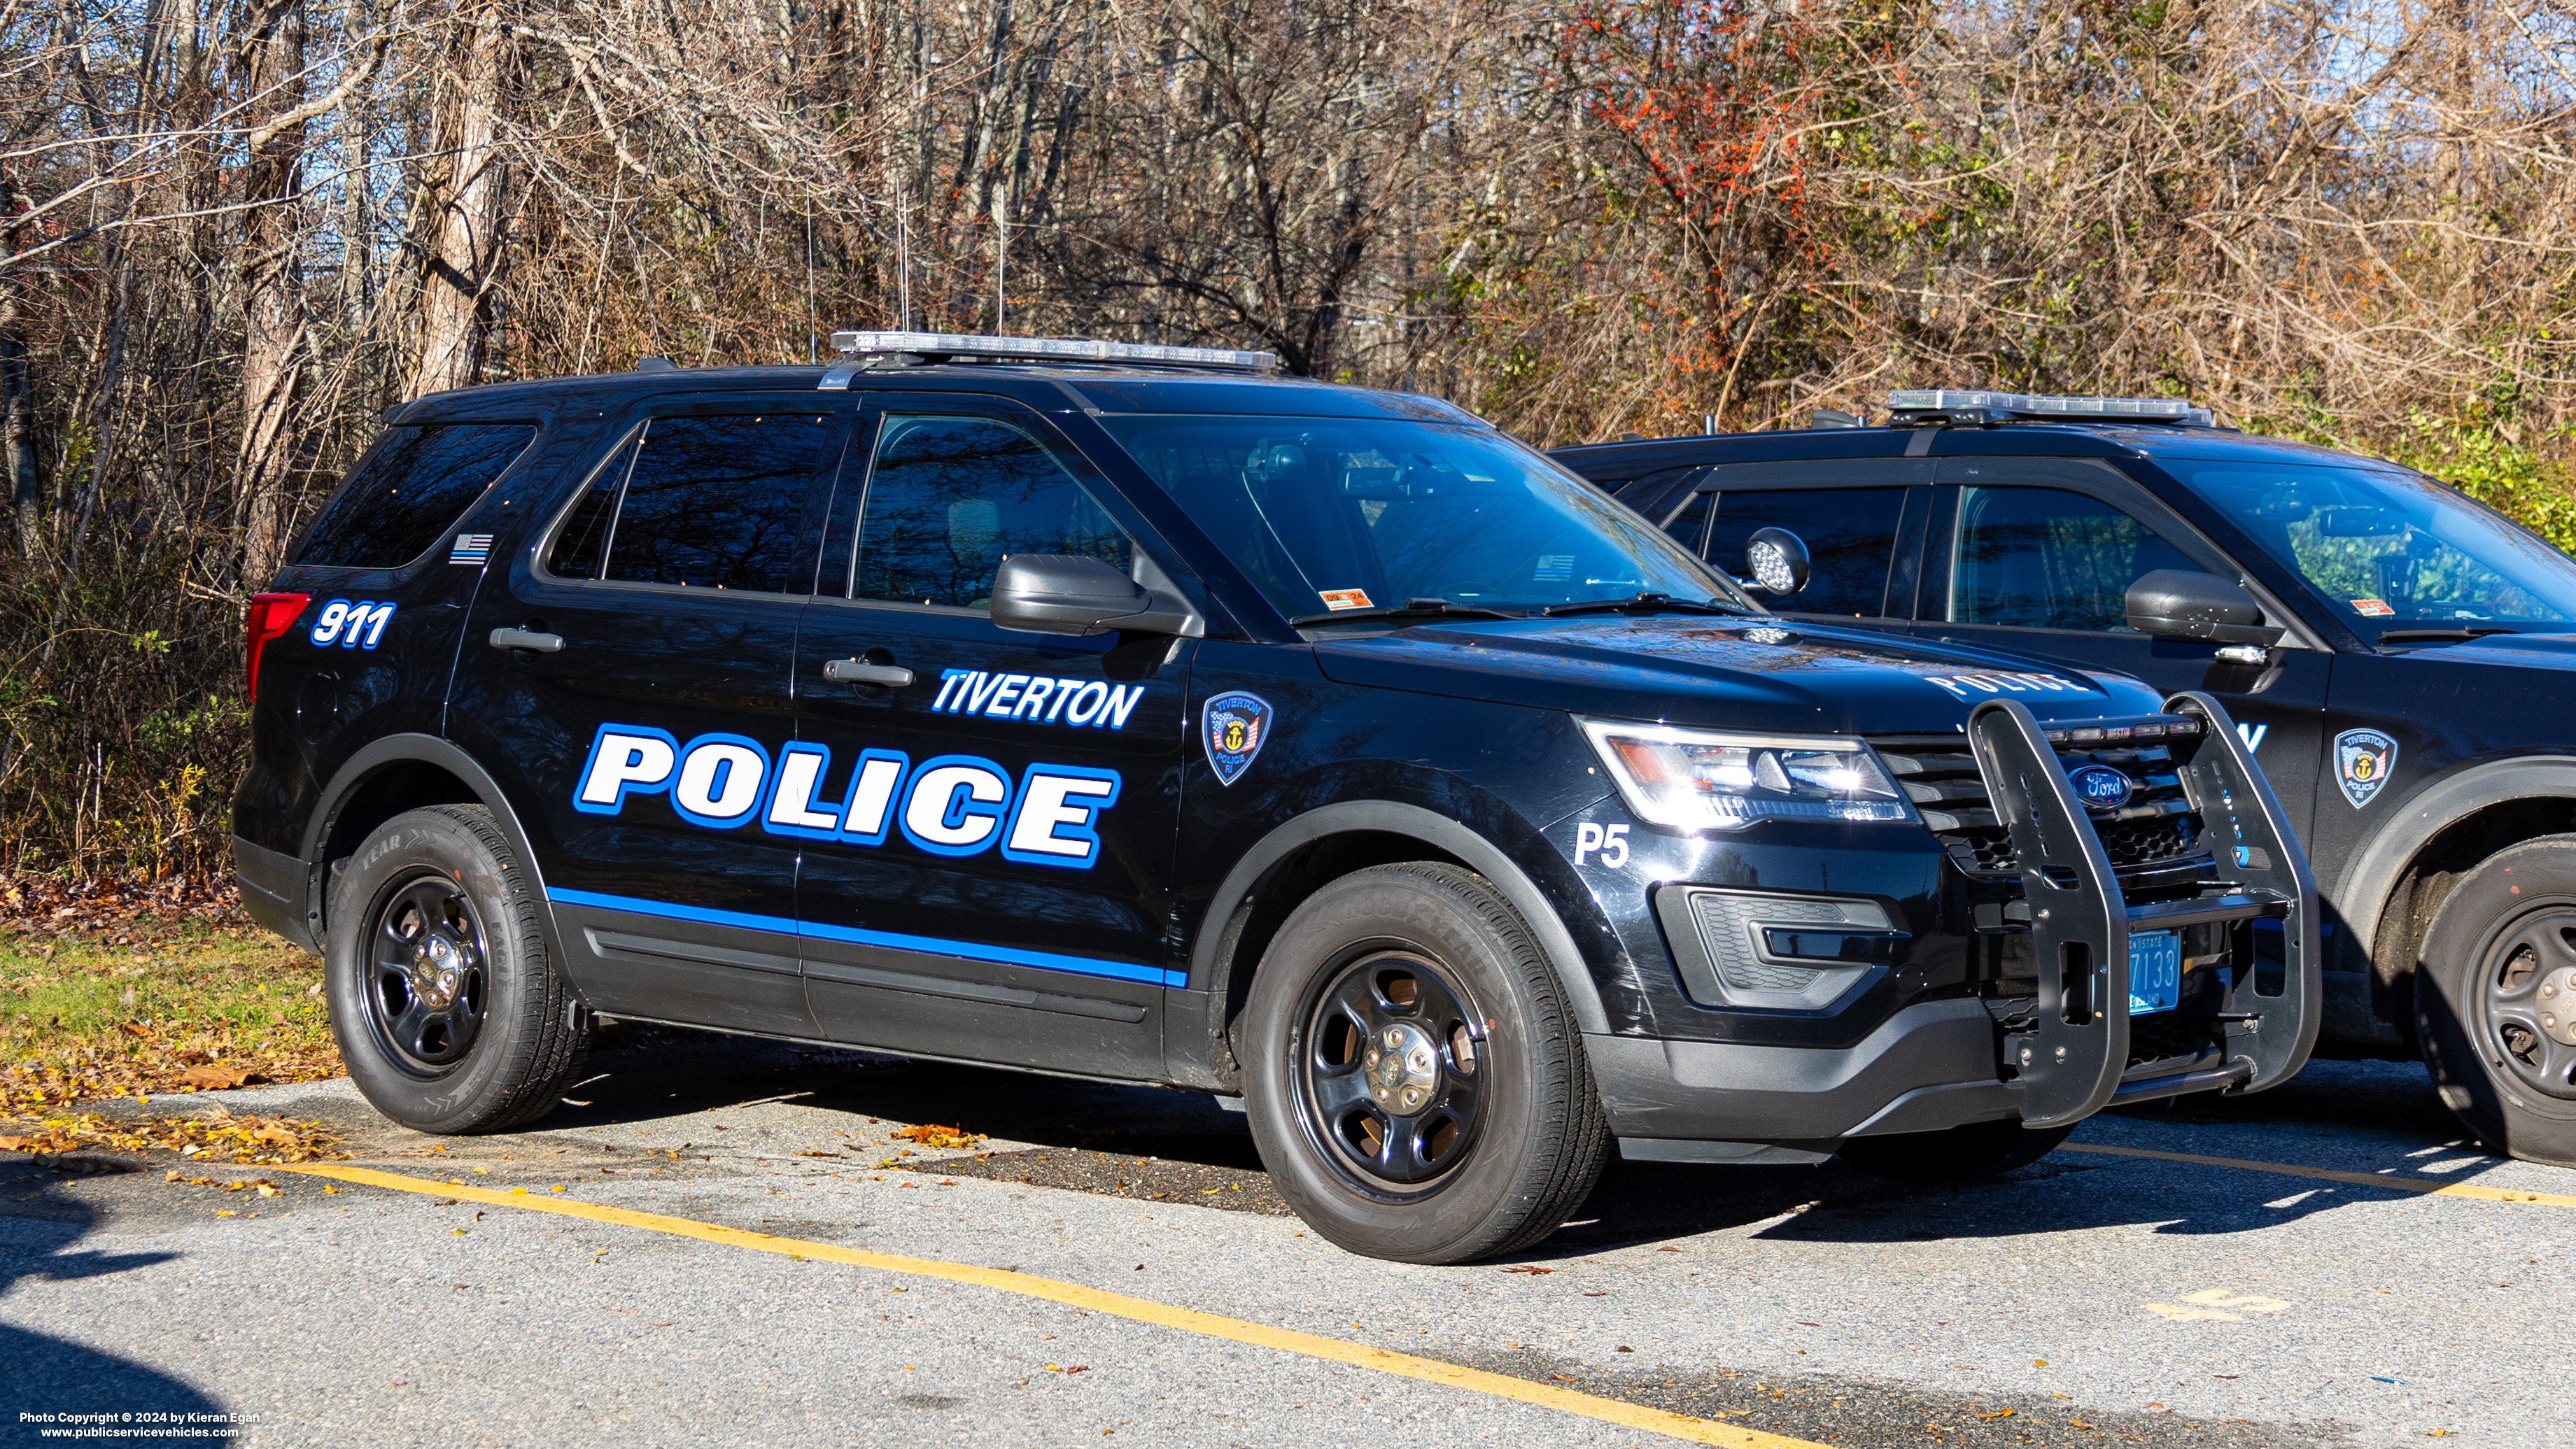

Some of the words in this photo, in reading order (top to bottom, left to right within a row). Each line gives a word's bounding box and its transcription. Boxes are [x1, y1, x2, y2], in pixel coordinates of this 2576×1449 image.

[311, 600, 396, 649] 911
[1924, 674, 2090, 695] POLICE
[932, 669, 1144, 728] TIVERTON
[1216, 697, 1262, 716] TIVERTON
[2344, 733, 2388, 750] TIVERTON
[1216, 751, 1246, 765] POLICE
[1224, 764, 1233, 773] RI
[2086, 772, 2123, 796] Ford
[2346, 779, 2376, 791] POLICE
[575, 726, 1122, 867] POLICE
[1574, 821, 1630, 868] P5
[2141, 935, 2162, 949] STATE
